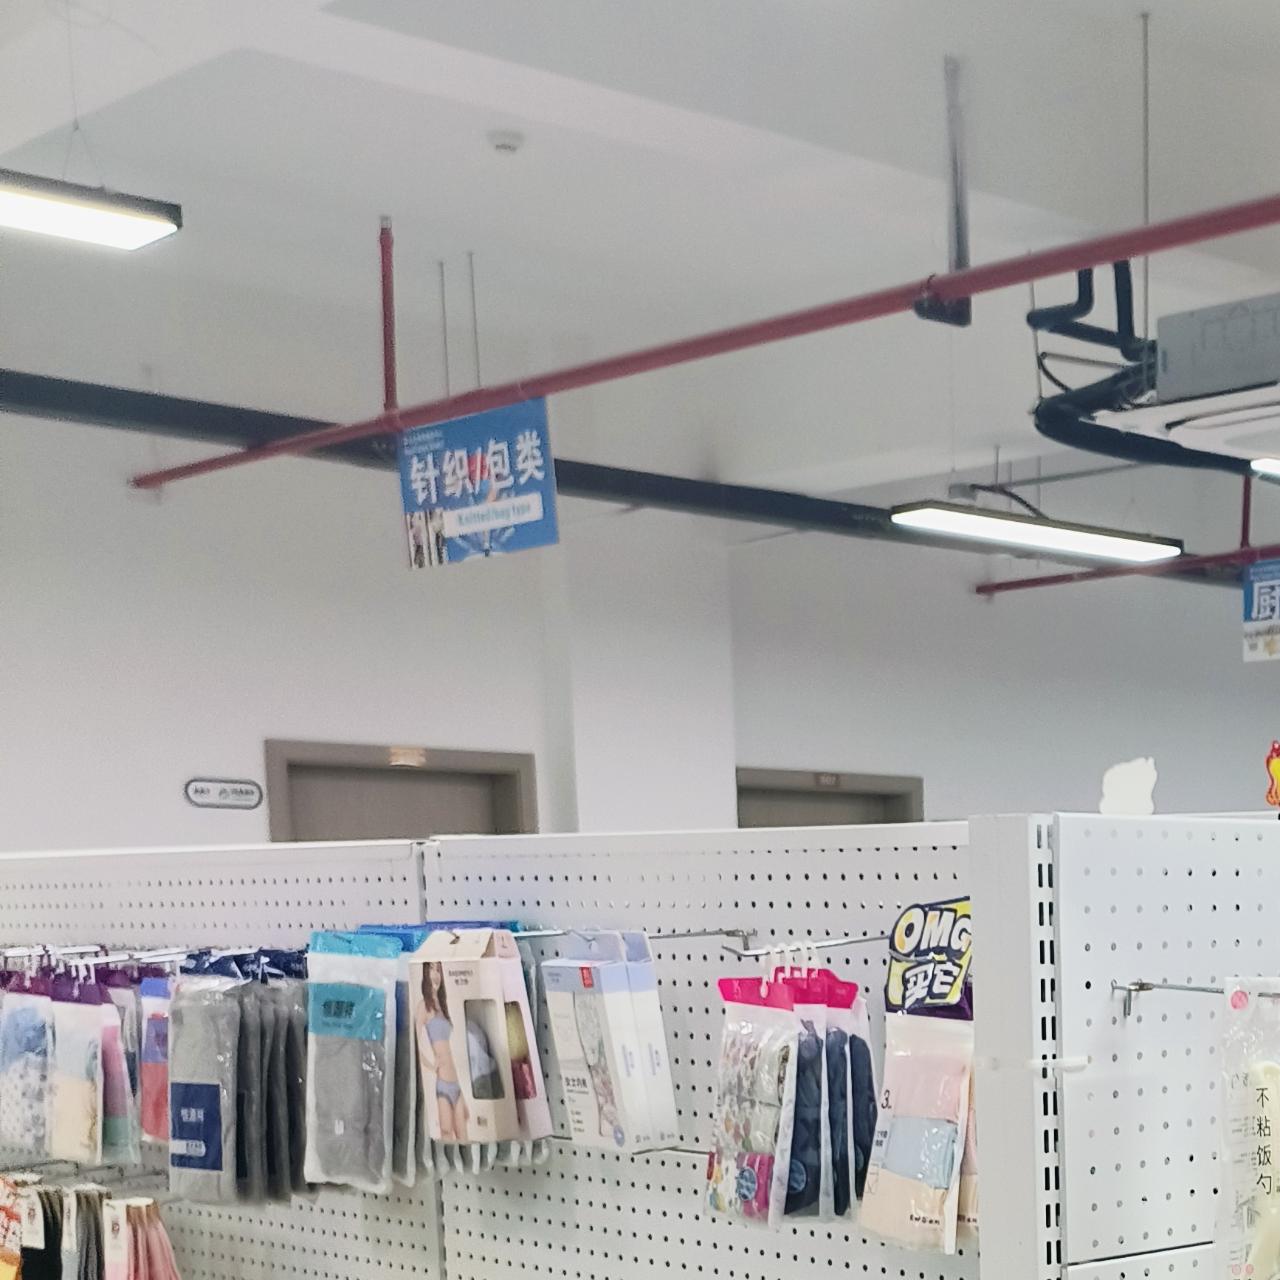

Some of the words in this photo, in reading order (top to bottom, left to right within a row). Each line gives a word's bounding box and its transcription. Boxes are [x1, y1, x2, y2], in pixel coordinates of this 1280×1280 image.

[894, 905, 972, 955] OMG
[1255, 1087, 1272, 1196] 不粘饭勺
